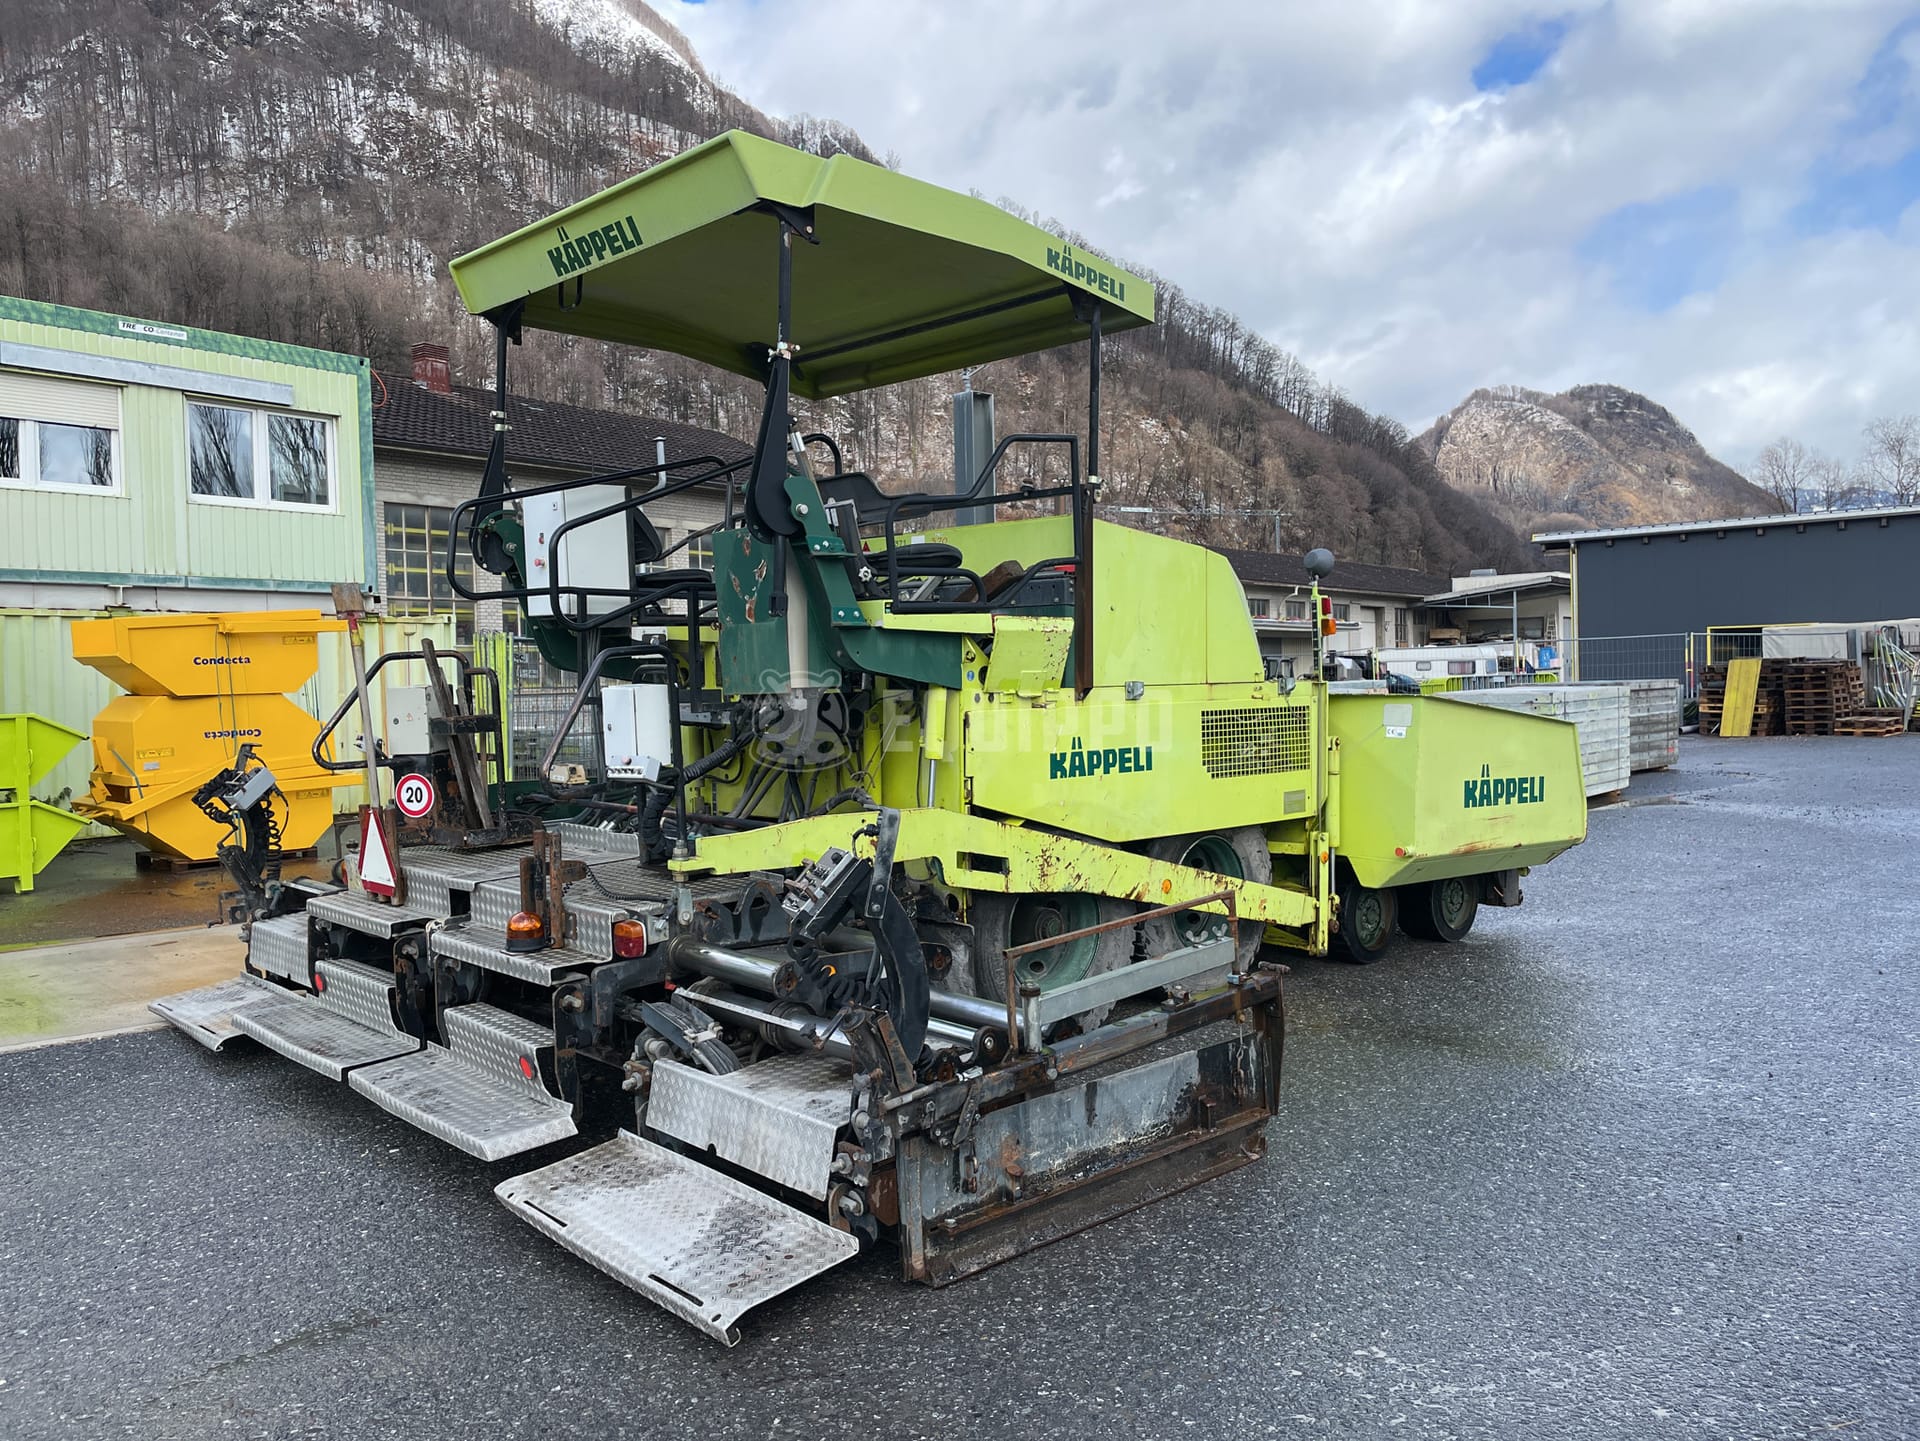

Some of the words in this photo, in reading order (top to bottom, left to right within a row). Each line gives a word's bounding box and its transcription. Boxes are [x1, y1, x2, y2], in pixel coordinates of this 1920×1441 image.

[546, 215, 643, 277] KÄPPELI
[1046, 245, 1125, 302] KÄPPELI
[193, 656, 251, 665] Condecta
[204, 728, 262, 739] Condecta
[1049, 736, 1153, 779] KÄPPELI
[405, 786, 423, 803] 20
[1464, 763, 1545, 808] KÄPPELI
